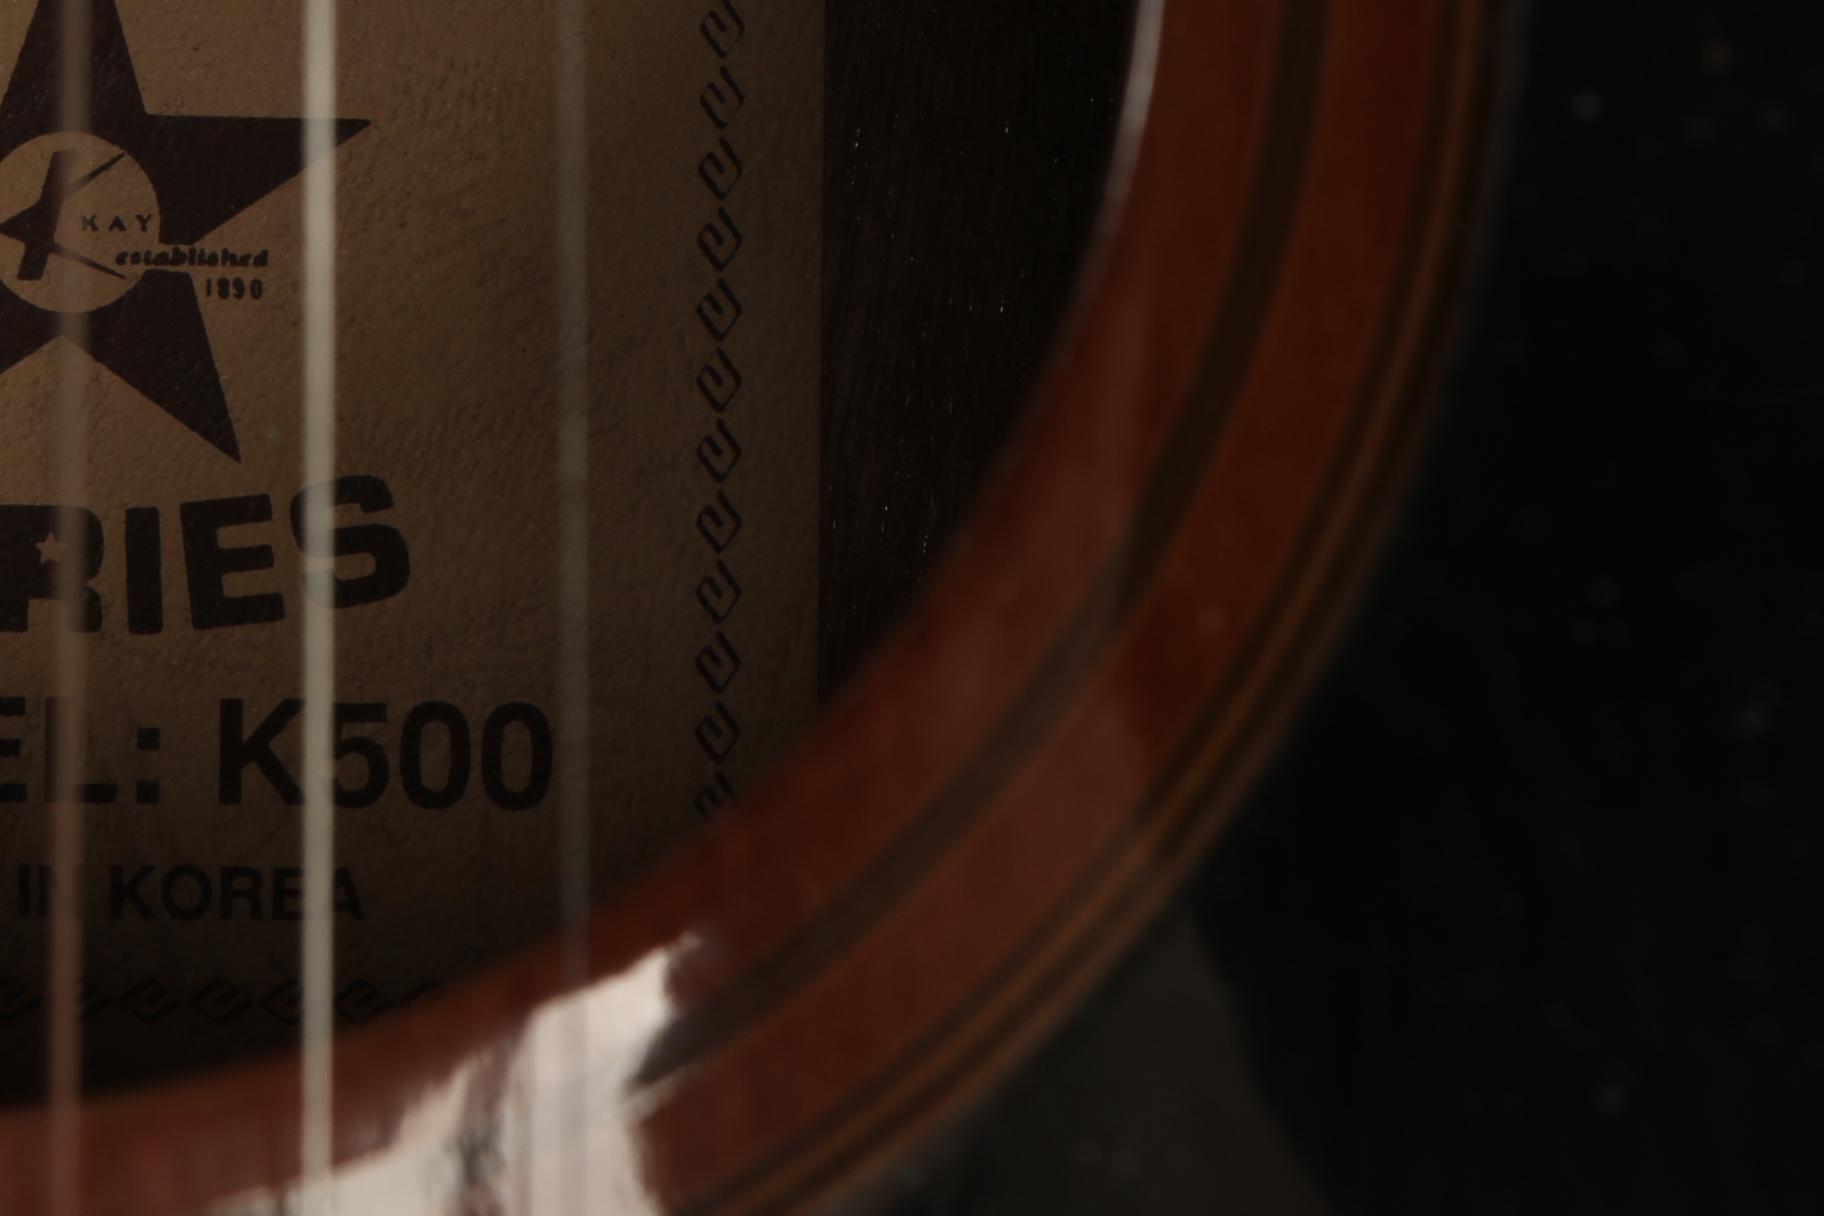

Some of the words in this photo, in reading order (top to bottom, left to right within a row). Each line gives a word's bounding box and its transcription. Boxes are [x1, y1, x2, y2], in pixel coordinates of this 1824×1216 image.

[81, 214, 153, 232] KAY
[115, 247, 269, 267] established
[206, 277, 264, 300] 1890
[218, 698, 553, 812] K500
[109, 865, 366, 921] KOREA
